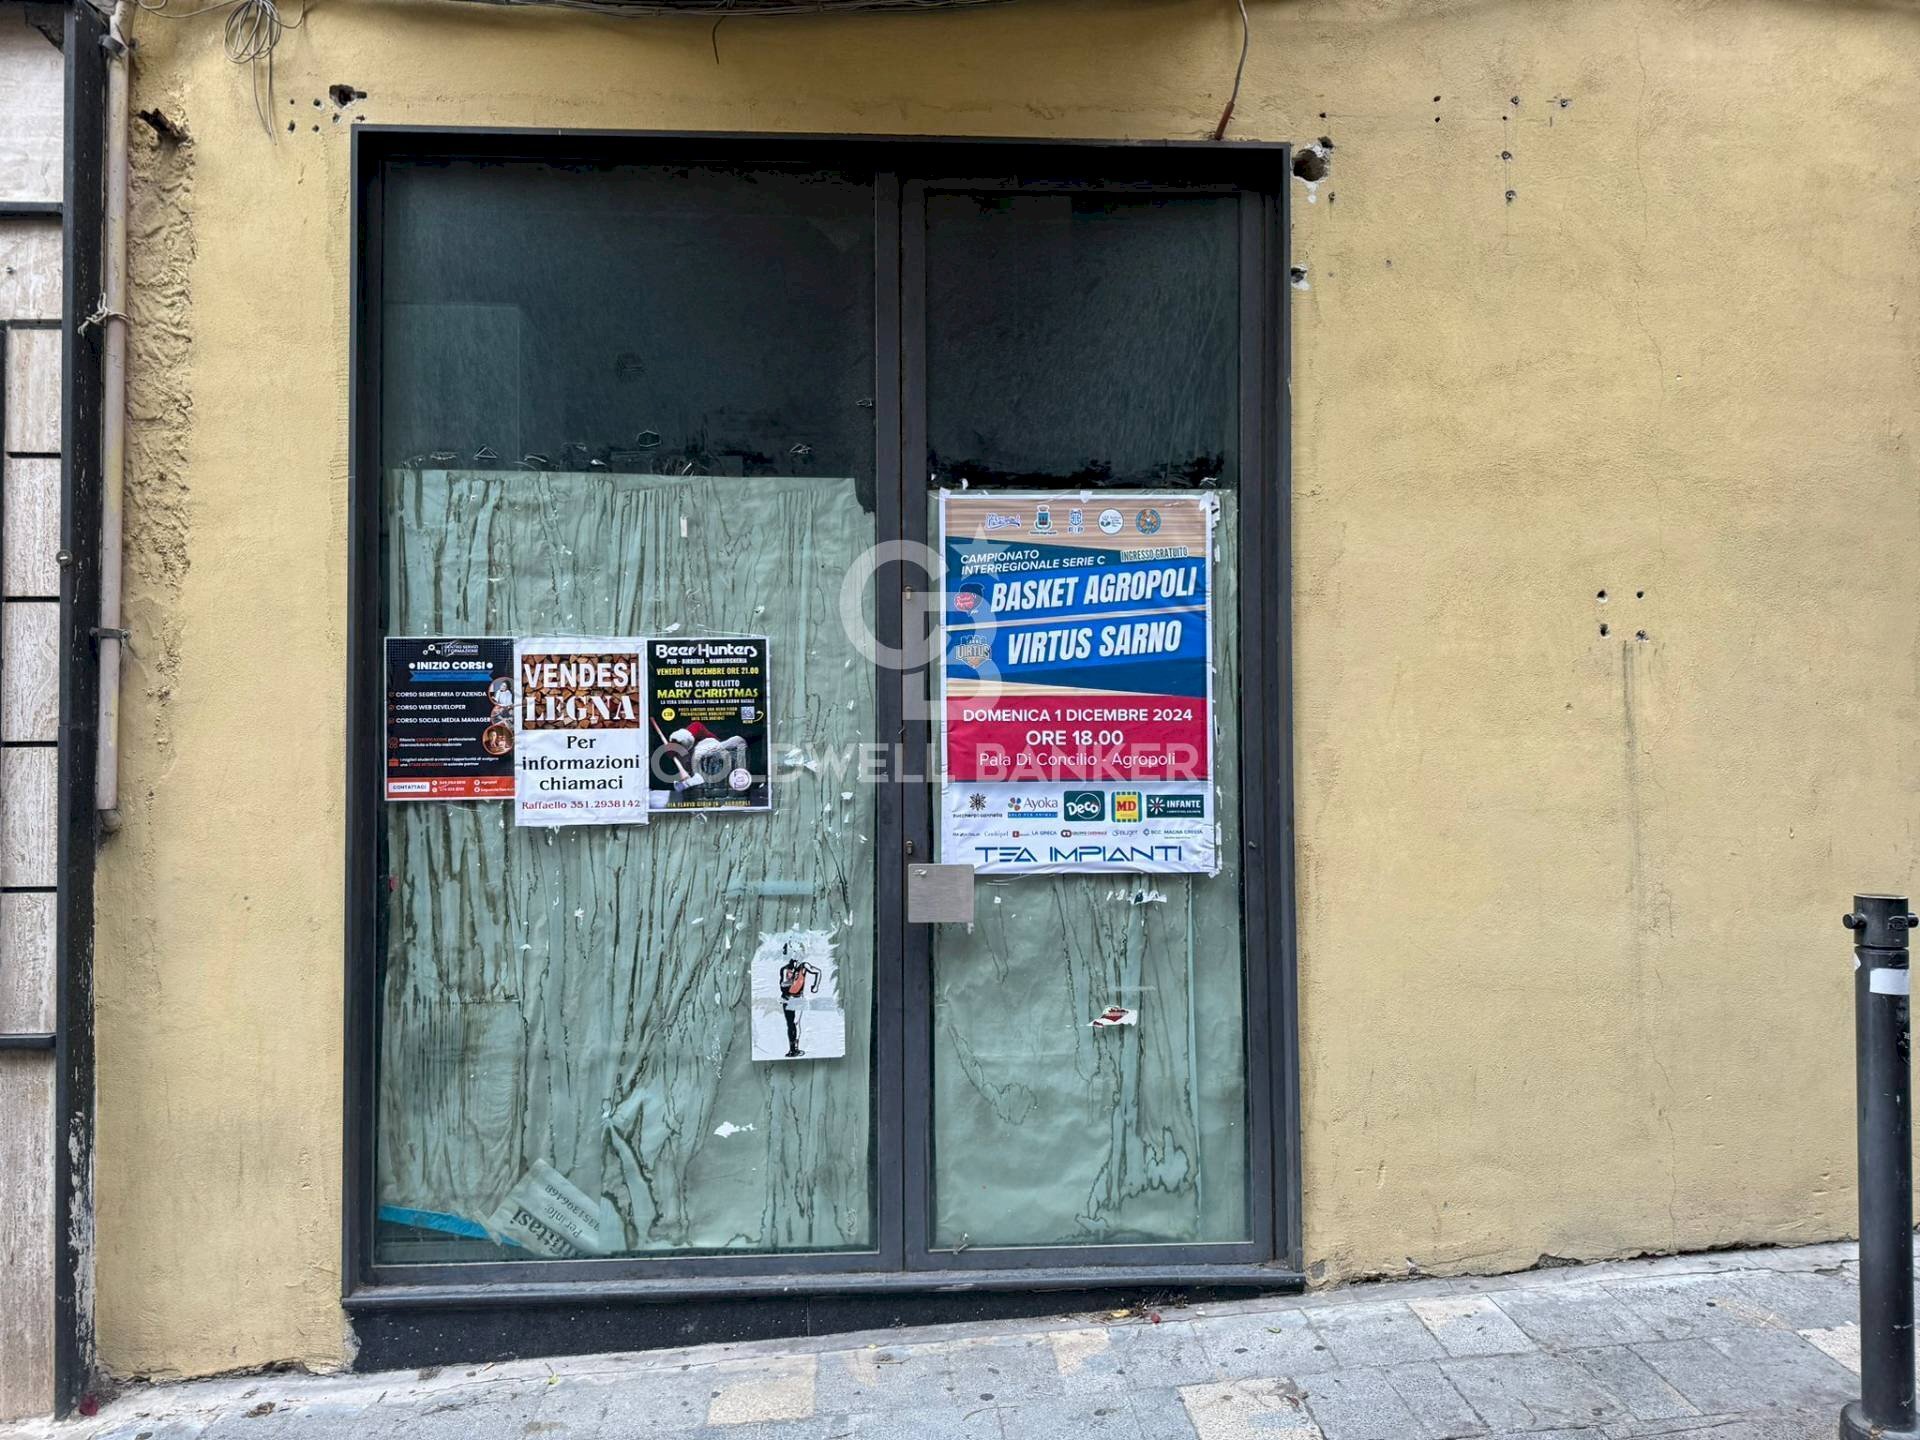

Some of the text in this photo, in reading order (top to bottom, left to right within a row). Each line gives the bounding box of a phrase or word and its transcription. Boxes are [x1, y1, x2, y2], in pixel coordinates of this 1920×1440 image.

[960, 549, 1039, 564] CAMPIONATO
[1121, 547, 1188, 562] INGRESSO GRATUITO
[961, 555, 1106, 576] INTERREGIONALE SERIE C
[990, 566, 1198, 613] BASKET AGROPOLI
[1007, 619, 1182, 665] VIRTUS SARNO
[955, 645, 990, 659] VIRTUS
[416, 661, 485, 670] INIZIO CORSI
[656, 666, 684, 676] VENERDÌ
[692, 667, 726, 675] DICEMBRE
[726, 667, 740, 675] ORE
[741, 667, 759, 675] 21.00
[524, 662, 638, 688] VENDESI
[675, 680, 693, 688] CENA
[657, 688, 758, 699] MARY CHRISTMAS
[525, 695, 636, 721] LEGNA
[963, 708, 1193, 722] DOMENICA 1 DICEMBRE 2024
[566, 735, 596, 749] Per
[1025, 730, 1124, 746] ORE 18.00
[522, 755, 640, 771] informazioni
[979, 753, 1011, 766] Pala
[1016, 753, 1032, 766] Di
[1036, 753, 1097, 766] Concilio
[1112, 753, 1176, 768] Agropoli
[539, 776, 623, 790] chiamaci
[522, 800, 641, 810] Raffaello 351.2938142
[1023, 796, 1058, 811] Ayoka
[1116, 801, 1136, 811] MD
[1166, 799, 1201, 808] INFANTE
[974, 845, 1182, 863] TEA IMPIANTI
[566, 1220, 585, 1239] Per
